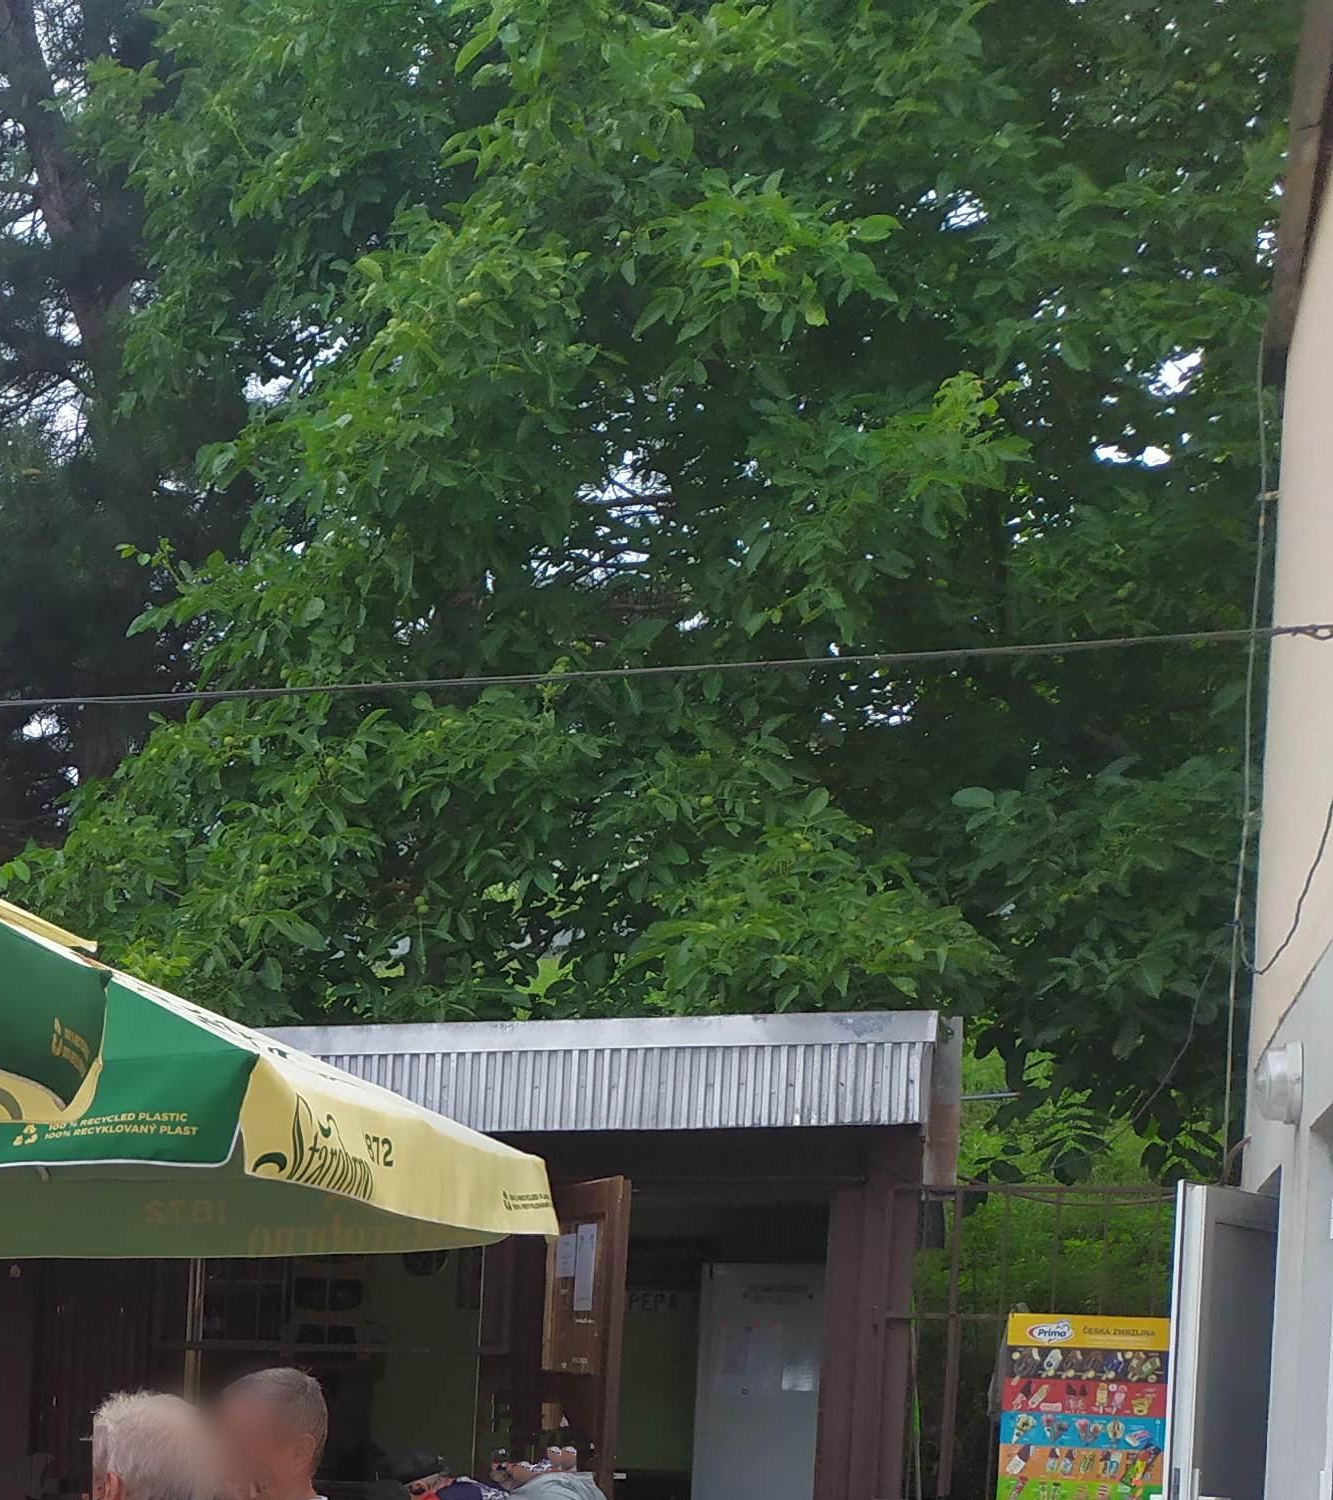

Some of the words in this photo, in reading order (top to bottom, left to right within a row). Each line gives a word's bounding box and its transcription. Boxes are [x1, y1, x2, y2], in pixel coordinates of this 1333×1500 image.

[80, 1112, 135, 1127] RECYCLED
[138, 1112, 189, 1122] PLASTIC
[159, 1125, 199, 1136] PLAST
[365, 1132, 393, 1168] 872
[1037, 1328, 1067, 1337] Prima
